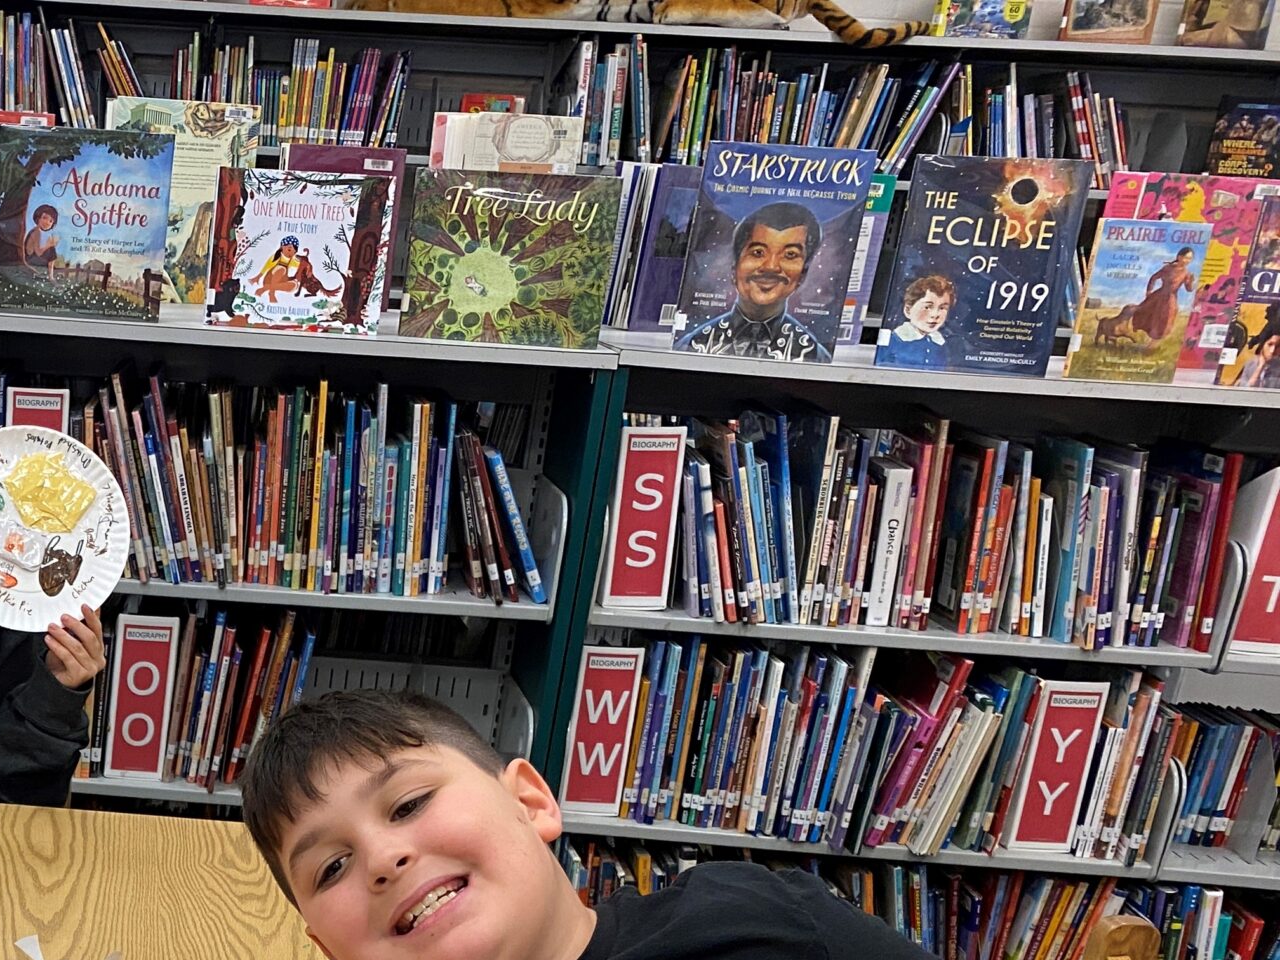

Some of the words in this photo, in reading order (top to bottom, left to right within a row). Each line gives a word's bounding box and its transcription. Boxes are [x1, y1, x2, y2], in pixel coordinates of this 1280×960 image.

[713, 150, 868, 187] STARSTRUCK
[52, 167, 161, 199] Alabama
[714, 183, 725, 192] THE
[726, 184, 749, 194] COSMIC
[750, 186, 776, 197] JOURNEY
[778, 187, 786, 195] OF
[787, 188, 801, 197] NEIL
[836, 190, 857, 201] TYSON
[253, 199, 274, 217] ONE
[276, 201, 317, 220] MILLION
[321, 203, 345, 222] TREES
[444, 182, 514, 217] Tree
[514, 189, 598, 233] Lady
[925, 191, 958, 210] THE
[71, 198, 149, 235] Spitfire
[277, 221, 282, 231] A
[284, 222, 298, 233] TRUE
[300, 223, 318, 235] STORY
[84, 237, 102, 247] Story
[111, 239, 133, 248] Harper
[927, 216, 1057, 250] ECLIPSE
[1106, 226, 1167, 243] PRAIRIE
[1170, 228, 1206, 245] GIRL
[967, 256, 998, 274] OF
[986, 280, 1050, 313] 1919
[267, 304, 288, 315] KRISTEN
[980, 332, 1004, 340] Changed
[990, 319, 1016, 327] Einstein's
[1016, 320, 1036, 328] Theory
[1006, 327, 1033, 335] Relativity
[983, 356, 1009, 364] ARNOLD
[1010, 358, 1038, 367] McCULLY
[17, 398, 60, 407] BIOGRAPHY
[632, 441, 677, 449] BIOGRAPHY
[175, 472, 190, 506] ABRAHAM
[632, 472, 665, 512] S
[181, 506, 194, 534] LINCOLN
[881, 517, 900, 555] Chance
[625, 530, 658, 568] S
[127, 631, 168, 640] BIOGRAPHY
[591, 659, 634, 668] BIOGRAPHY
[127, 661, 160, 696] O
[585, 688, 630, 724] W
[1052, 697, 1098, 706] BIOGRAPHY
[122, 712, 155, 747] O
[1050, 727, 1083, 763] Y
[577, 741, 622, 776] W
[1037, 780, 1070, 816] Y
